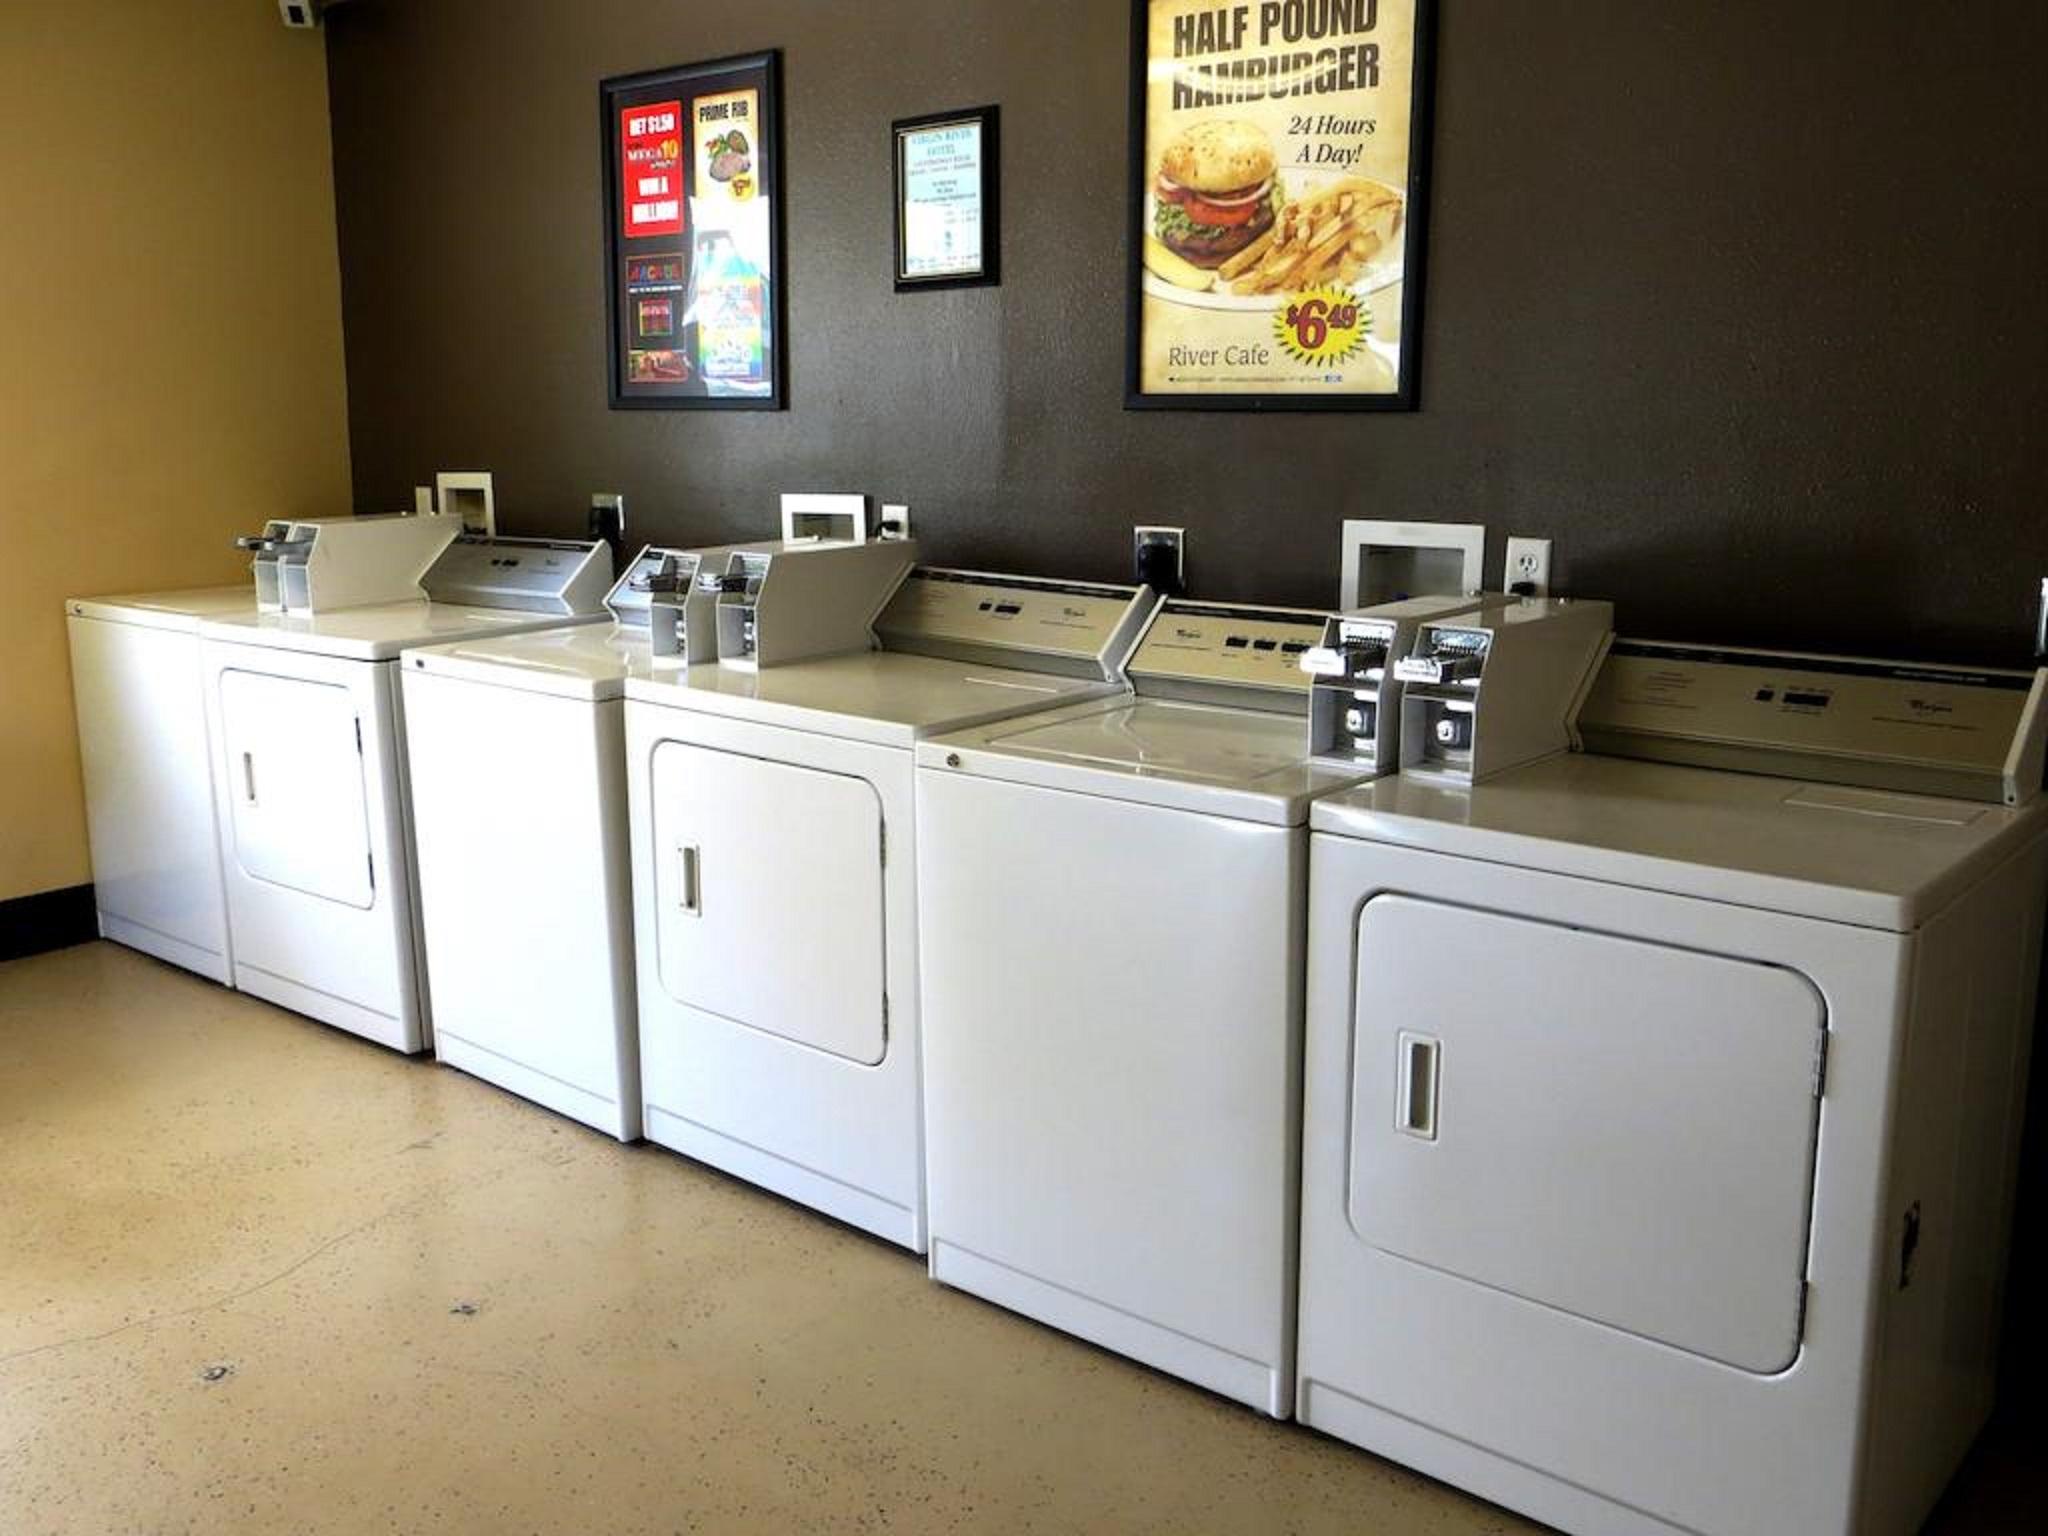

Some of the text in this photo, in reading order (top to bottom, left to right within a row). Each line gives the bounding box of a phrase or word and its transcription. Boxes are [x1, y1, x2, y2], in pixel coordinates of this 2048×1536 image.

[1174, 0, 1378, 58] HALF POUND
[1172, 43, 1379, 110] HAMBURGER
[699, 103, 729, 122] PRIME
[1288, 115, 1377, 135] 24 Hours
[1296, 143, 1363, 169] A Day!
[1168, 344, 1269, 366] River Cafe
